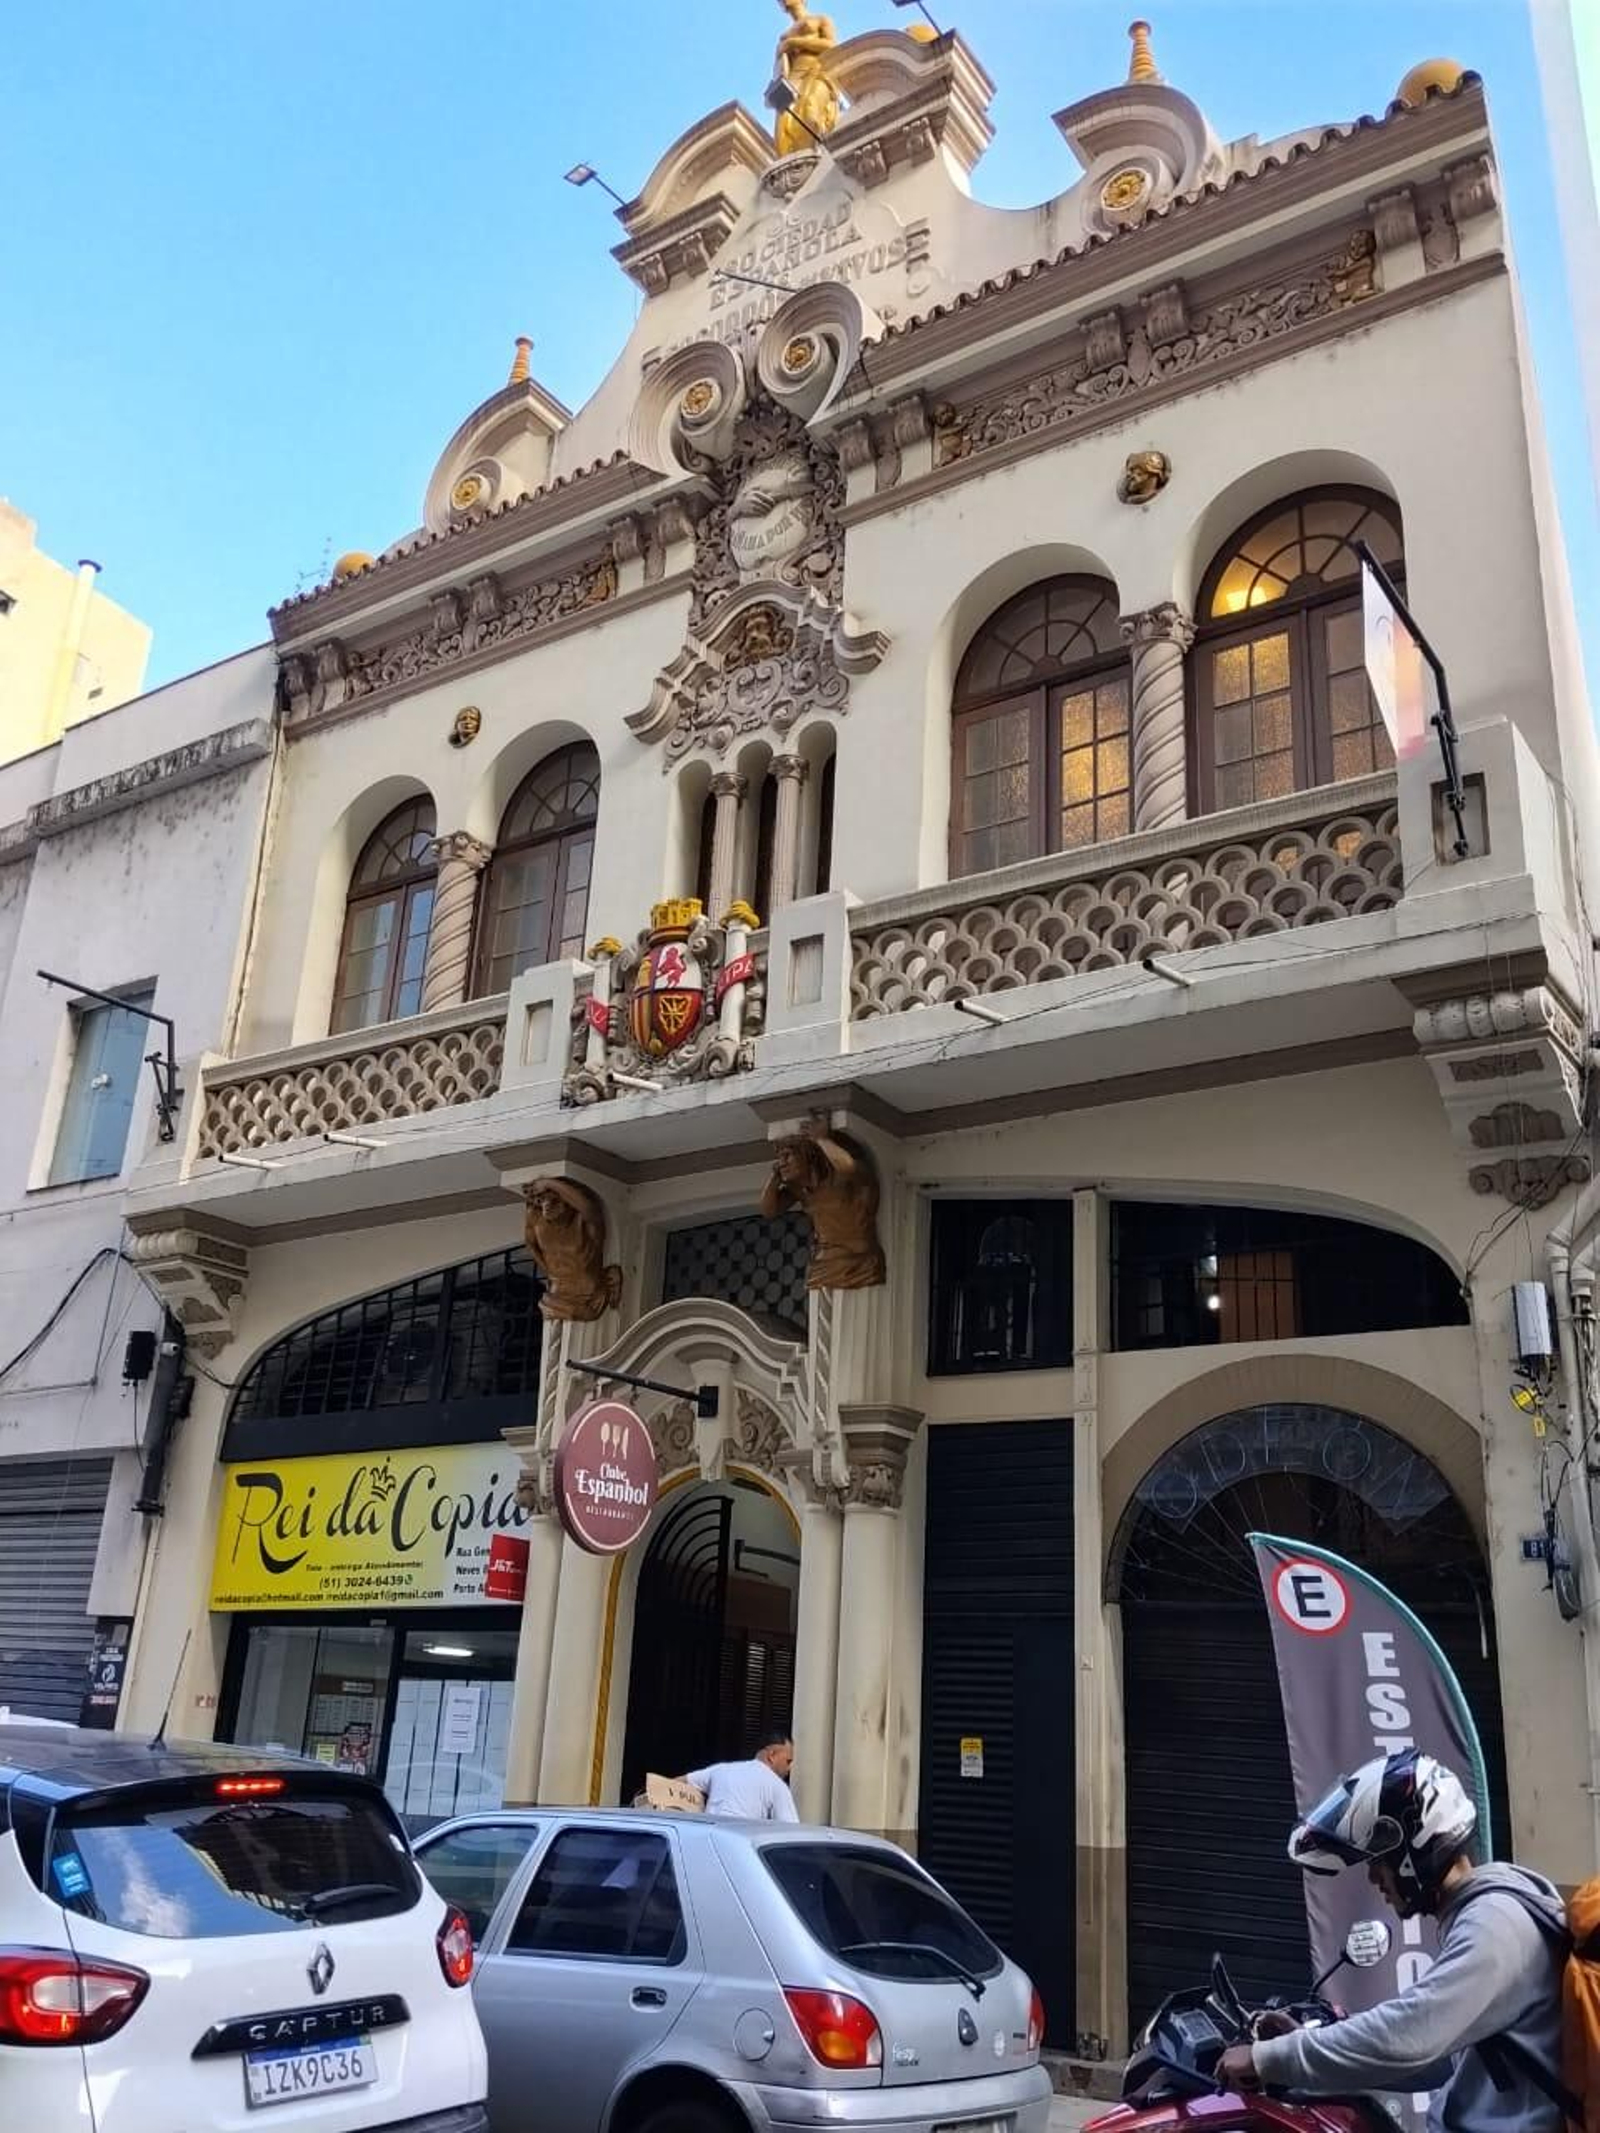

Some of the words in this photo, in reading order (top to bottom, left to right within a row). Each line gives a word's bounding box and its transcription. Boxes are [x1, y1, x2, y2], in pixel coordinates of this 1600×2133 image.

[575, 1469, 649, 1506] Espanhol
[232, 1472, 316, 1574] Rei
[326, 1466, 383, 1537] da
[391, 1465, 533, 1559] Copia
[319, 1577, 341, 1589] (51)
[1290, 1575, 1331, 1618] E
[250, 2005, 386, 2040] CAPTUR
[264, 2050, 363, 2095] IZK9C36
